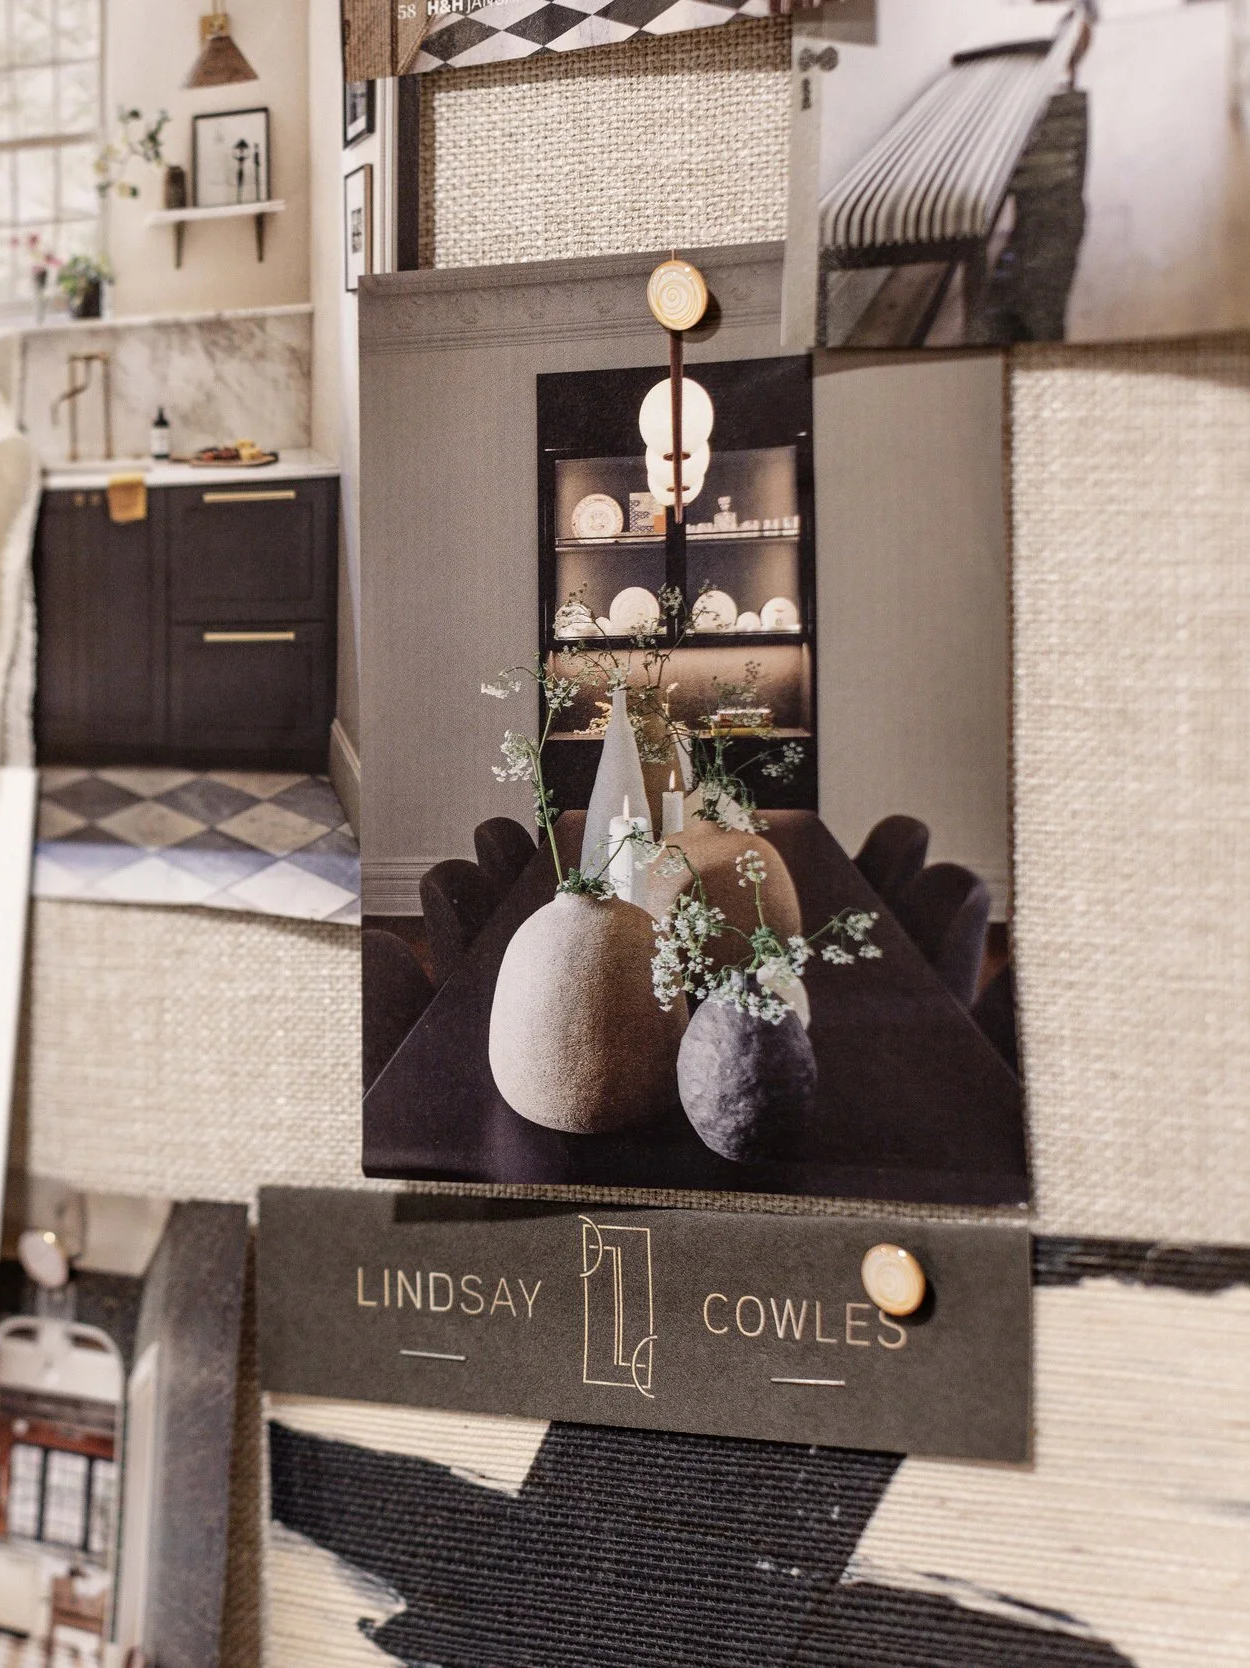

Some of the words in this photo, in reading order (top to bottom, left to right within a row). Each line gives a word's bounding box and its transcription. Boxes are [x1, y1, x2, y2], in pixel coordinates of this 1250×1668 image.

[397, 3, 417, 20] 58
[427, 0, 464, 16] H&H
[357, 1266, 542, 1318] LINDSAY
[703, 1292, 908, 1349] COWLES
